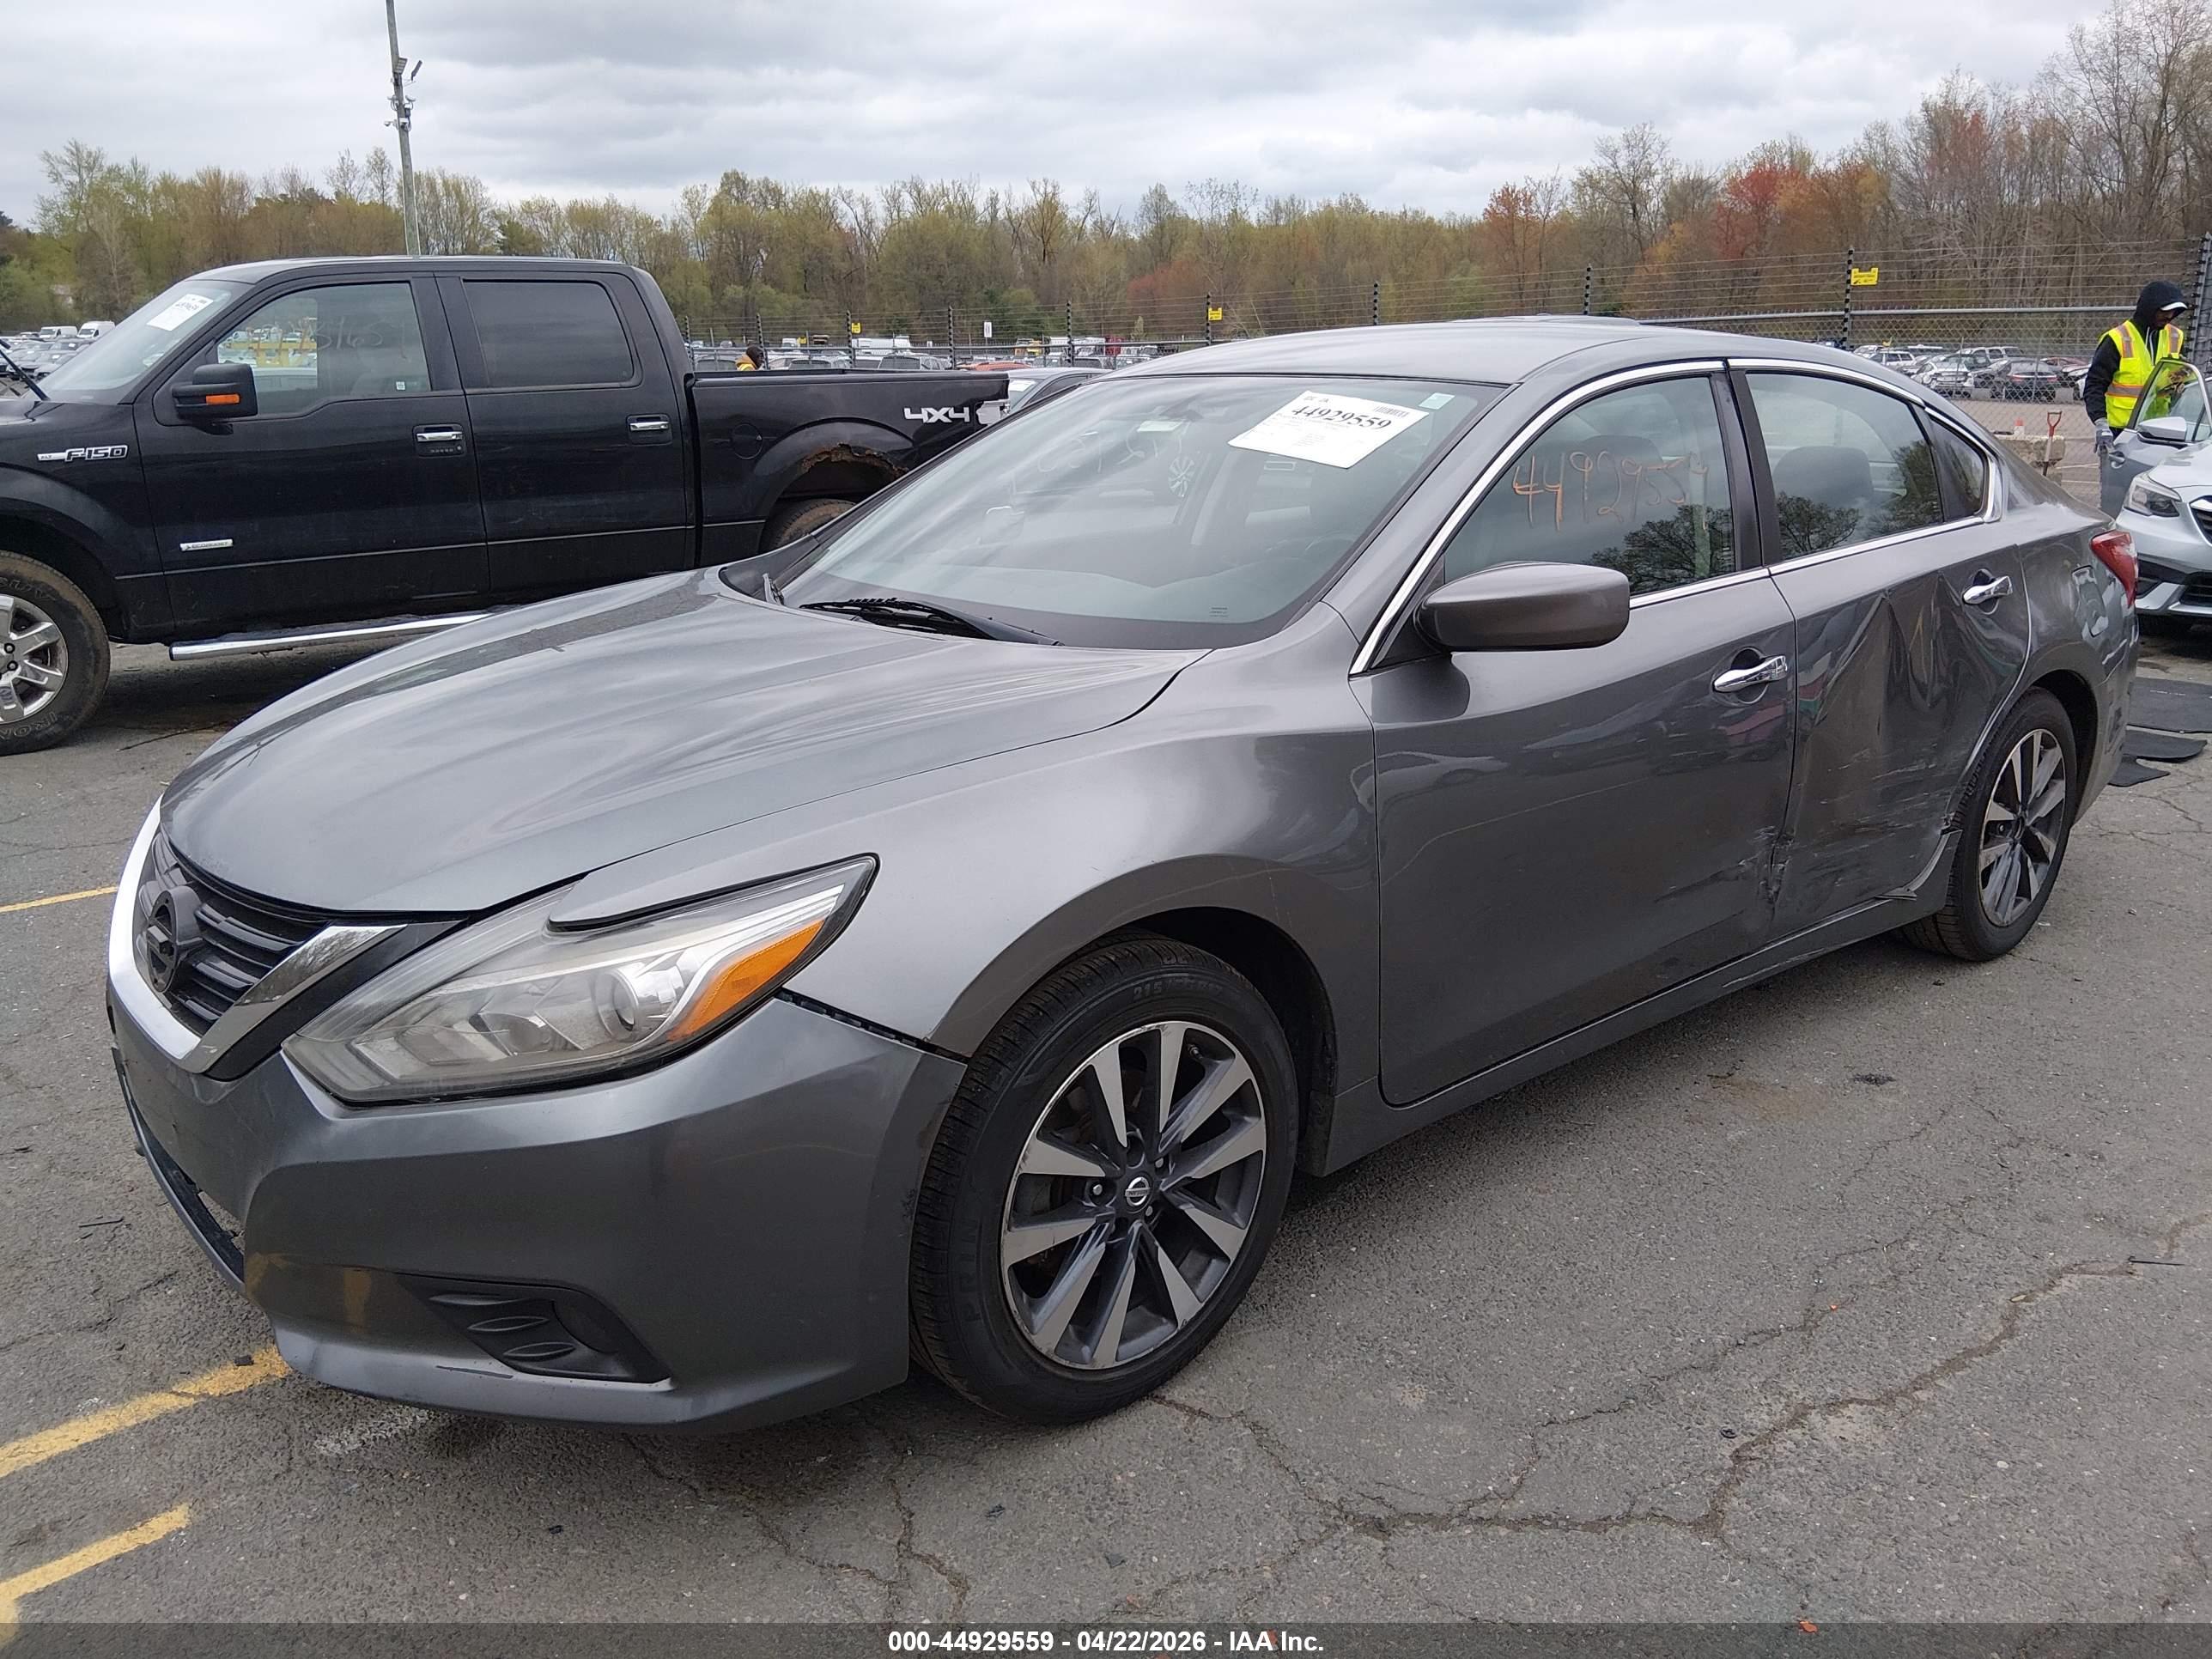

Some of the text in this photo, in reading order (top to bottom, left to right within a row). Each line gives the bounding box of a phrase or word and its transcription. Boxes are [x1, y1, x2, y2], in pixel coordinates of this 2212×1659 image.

[903, 406, 971, 423] 4X4
[1291, 405, 1392, 429] 44929559
[64, 445, 129, 462] F-150
